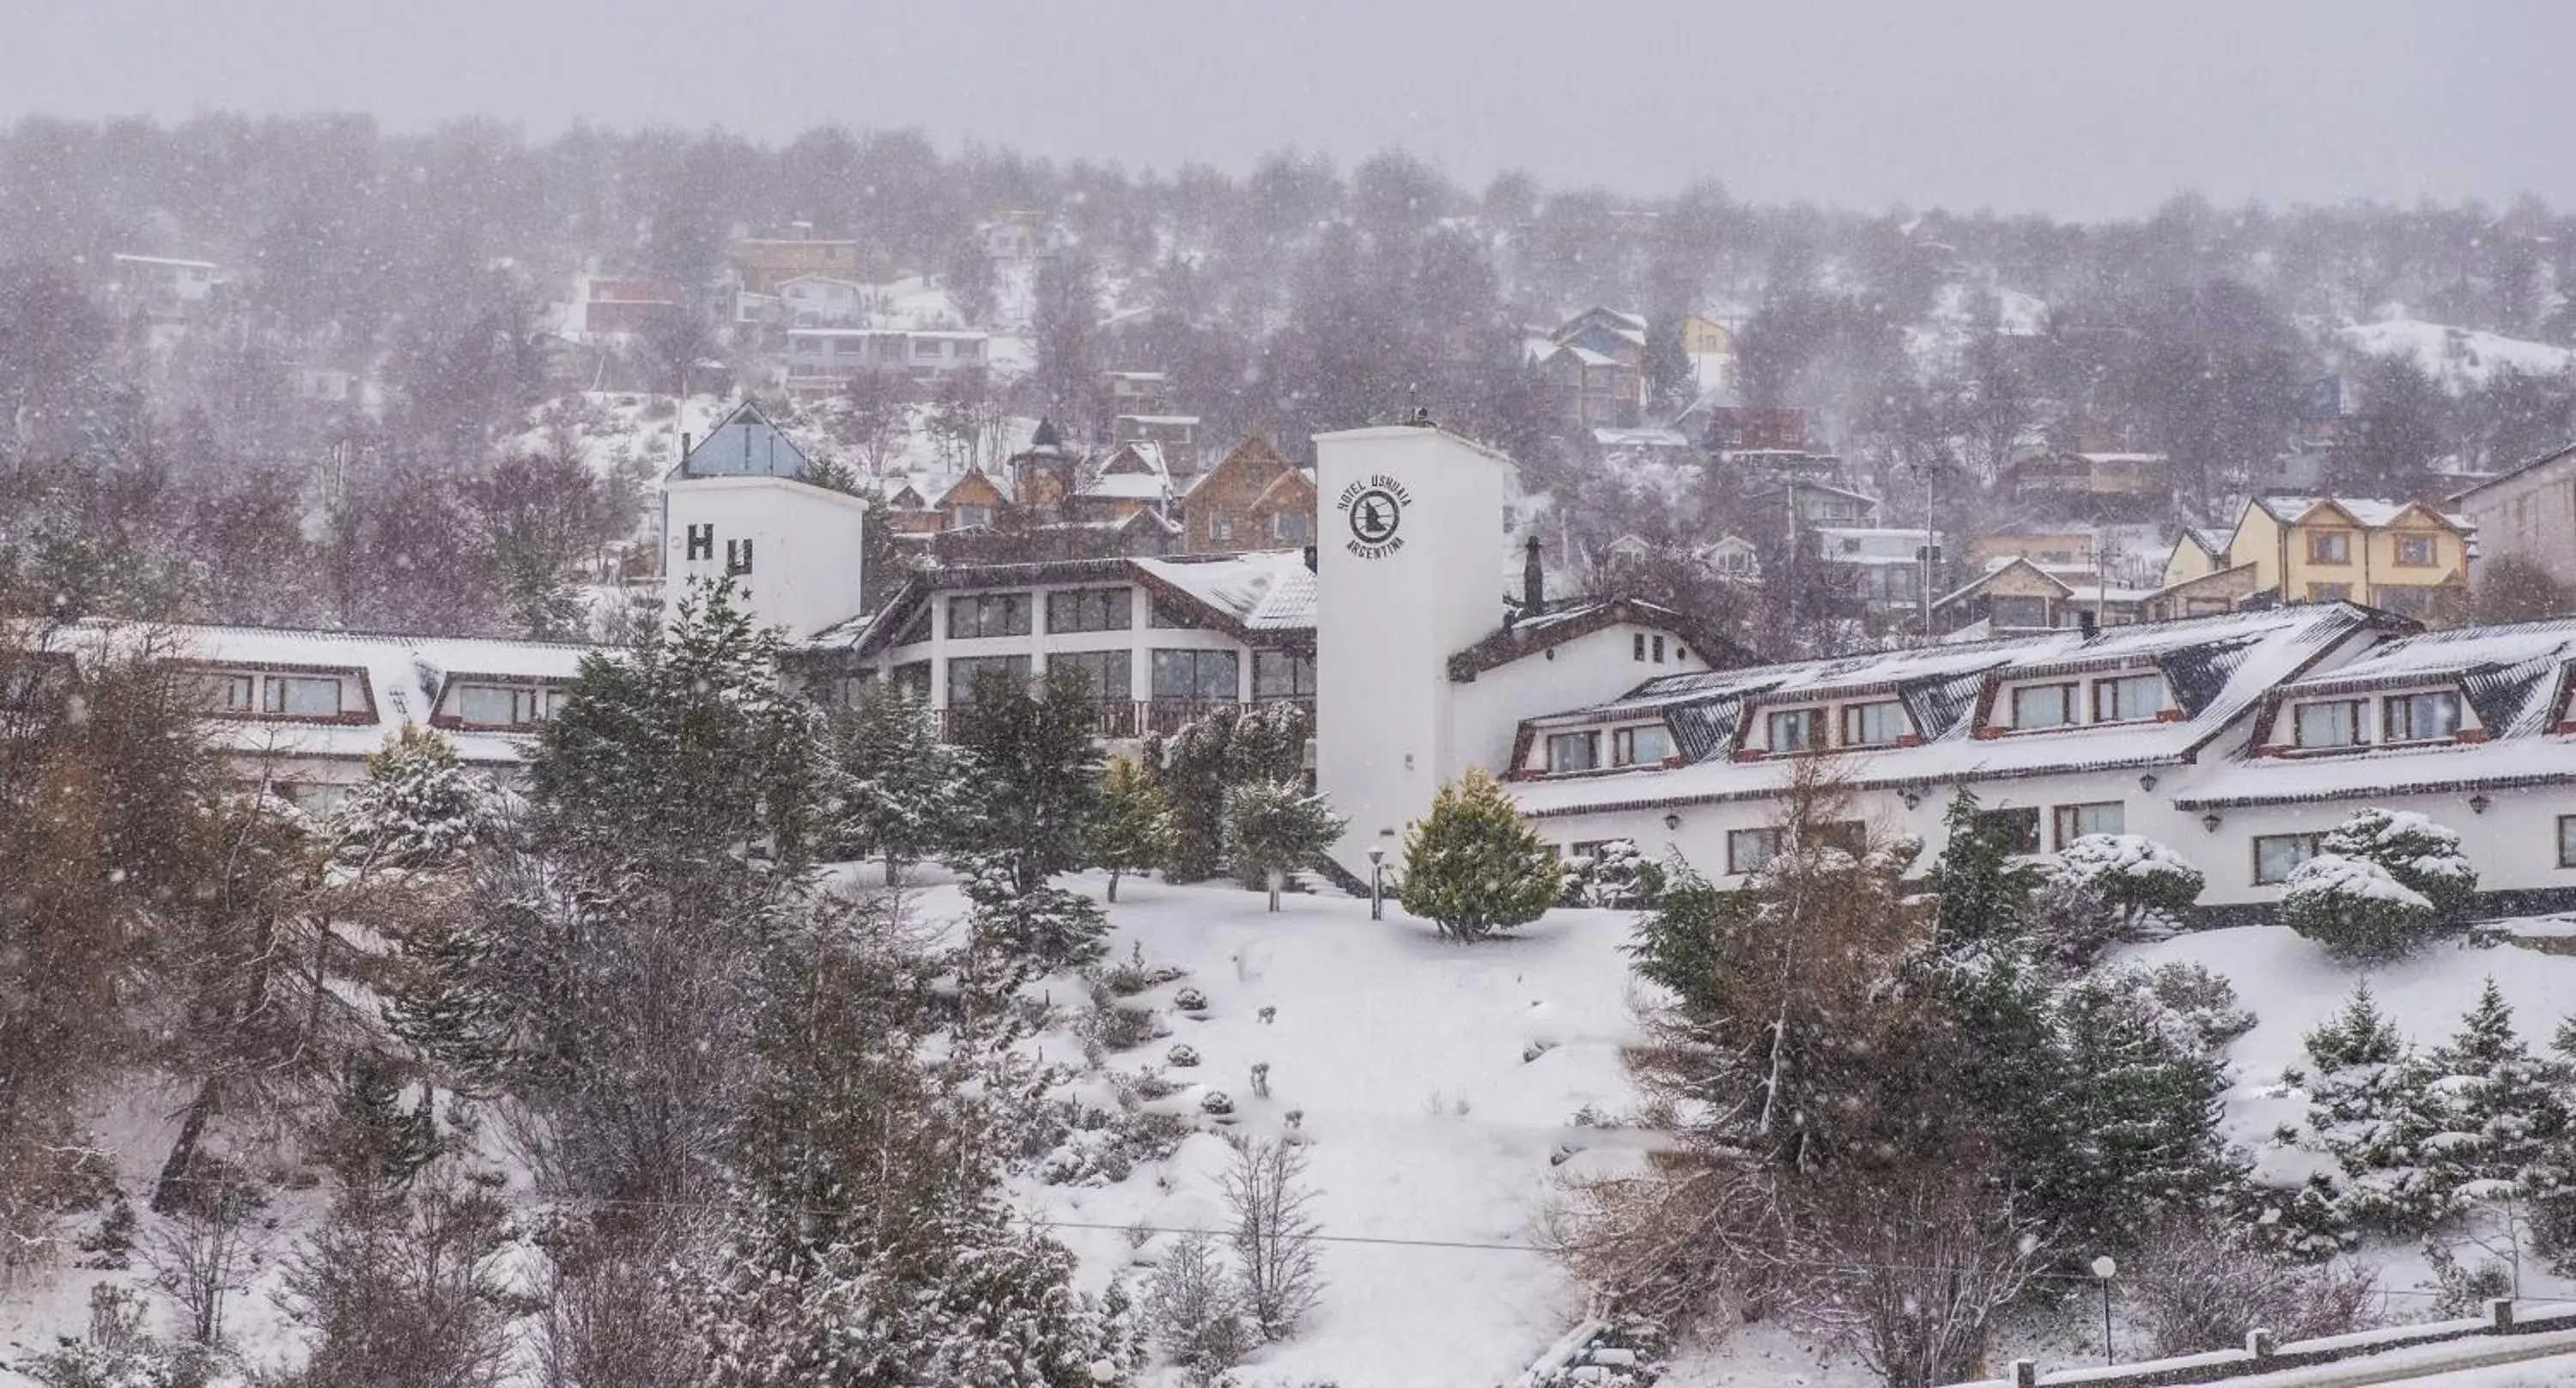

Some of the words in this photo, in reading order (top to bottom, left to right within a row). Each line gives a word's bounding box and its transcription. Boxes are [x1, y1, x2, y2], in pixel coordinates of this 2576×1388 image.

[1337, 481, 1366, 511] HOTEL
[1371, 474, 1412, 508] USHUAIA
[1346, 537, 1405, 560] ARGENTINA
